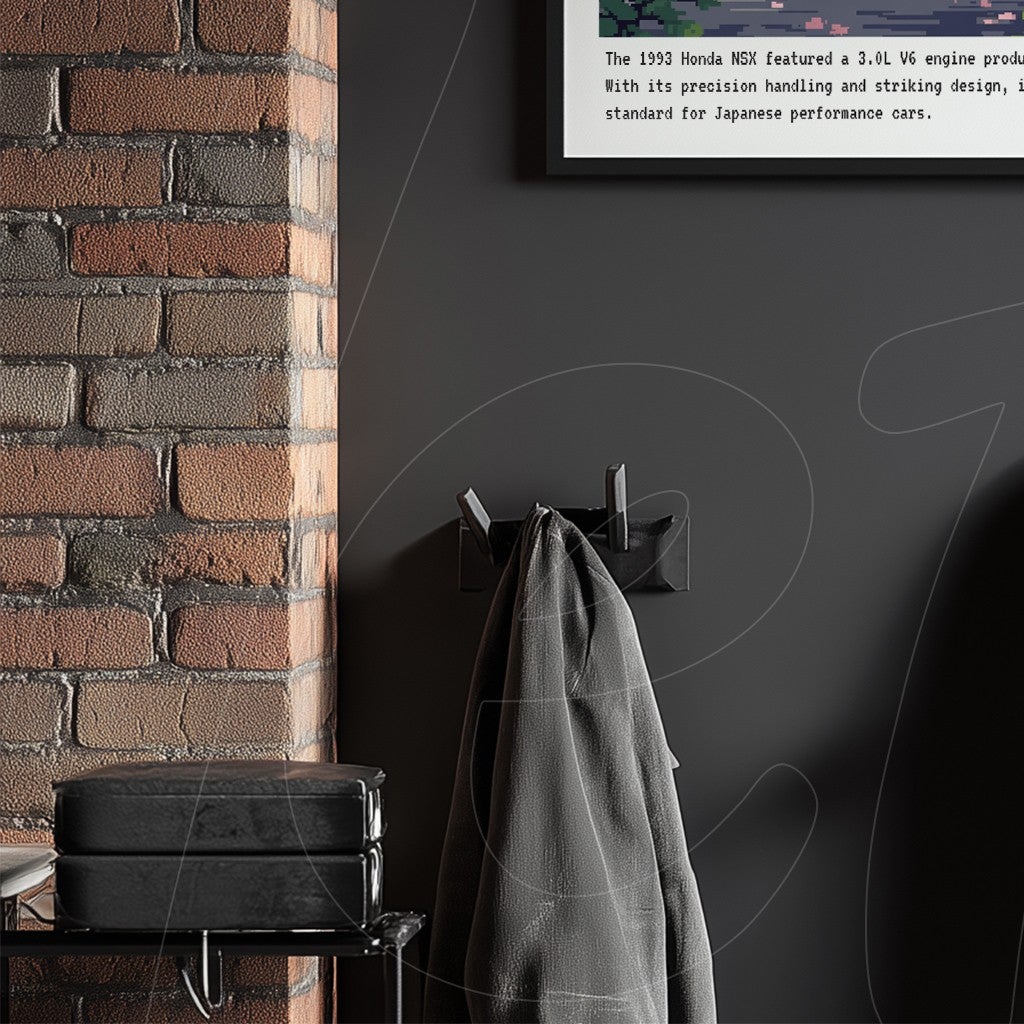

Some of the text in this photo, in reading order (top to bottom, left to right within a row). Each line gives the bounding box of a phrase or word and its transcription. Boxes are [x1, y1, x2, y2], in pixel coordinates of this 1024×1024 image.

[605, 51, 631, 66] The
[639, 51, 673, 66] 1993
[681, 51, 724, 66] Honda
[731, 51, 757, 66] NSX
[766, 50, 833, 66] featured
[840, 54, 850, 66] a
[858, 50, 892, 66] 3.0L
[899, 50, 917, 66] V6
[924, 50, 976, 69] engine
[605, 78, 639, 93] With
[648, 78, 673, 93] its
[681, 78, 757, 97] precision
[765, 78, 833, 97] handling
[841, 78, 867, 93] and
[874, 78, 942, 97] striking
[950, 78, 1008, 96] design,
[605, 105, 931, 124] standard for Japanese performance cars.
